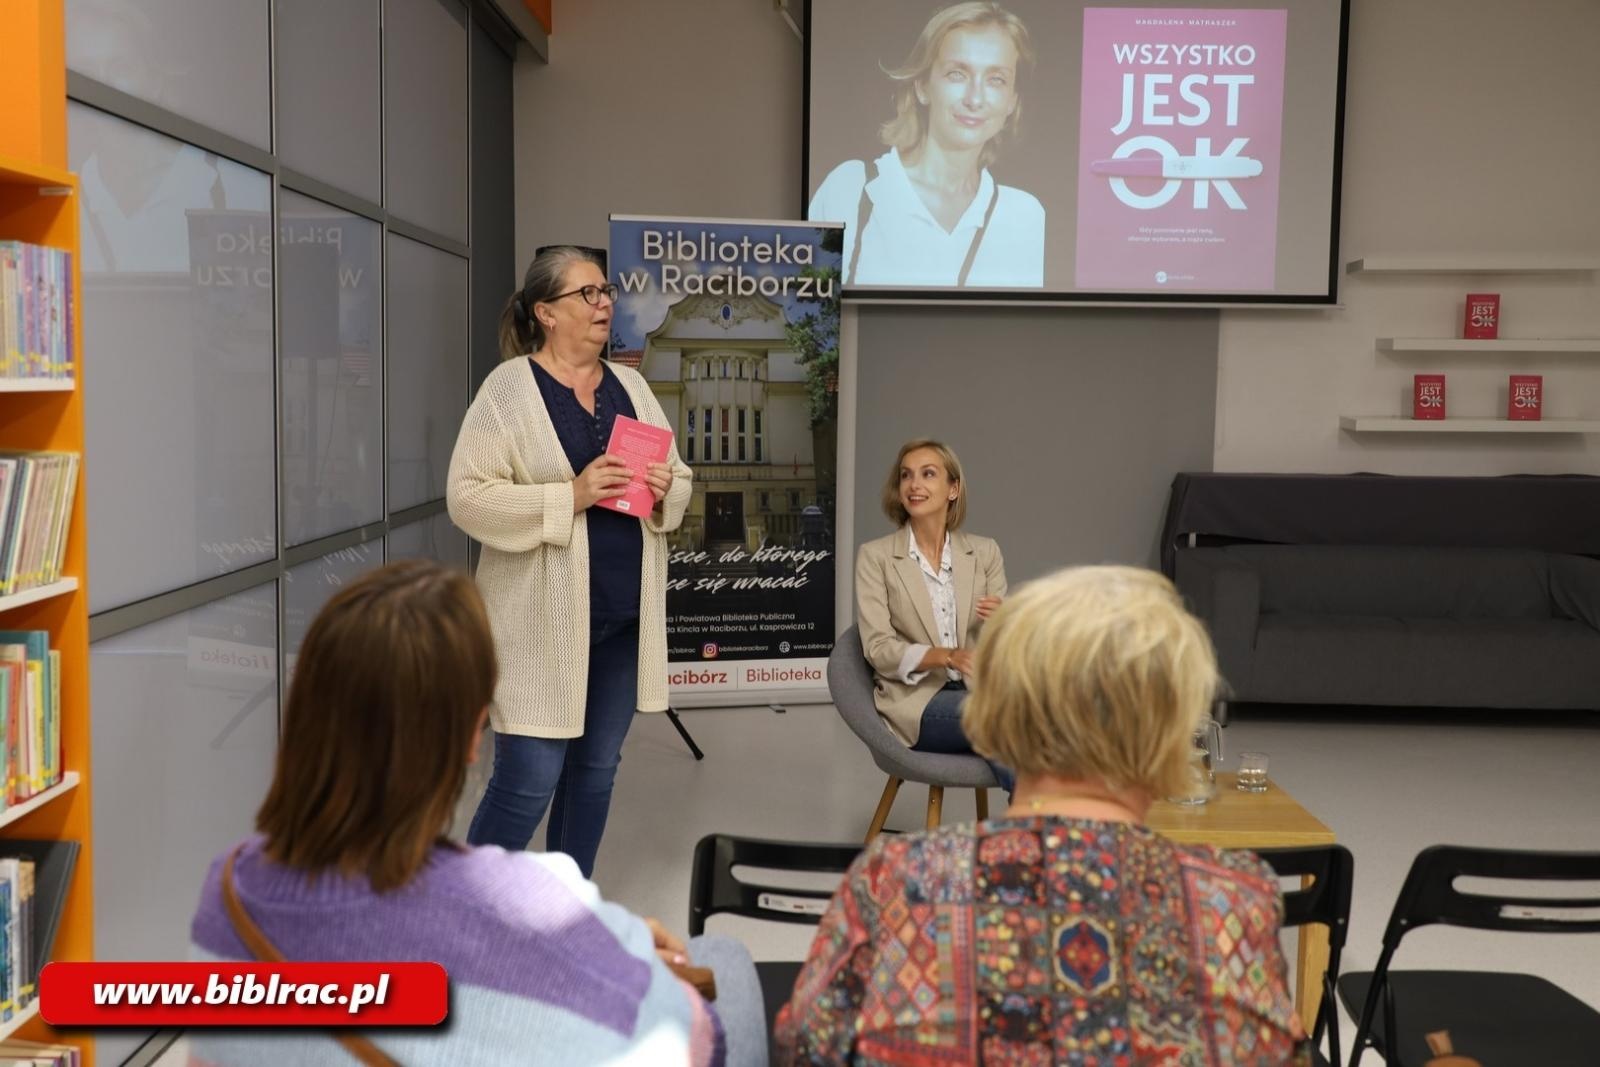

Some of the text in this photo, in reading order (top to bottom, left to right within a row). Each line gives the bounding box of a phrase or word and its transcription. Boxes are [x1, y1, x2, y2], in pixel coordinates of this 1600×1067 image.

[1113, 43, 1256, 66] WSZYSTKO
[1110, 73, 1255, 136] JEST
[1108, 135, 1251, 210] OK
[643, 230, 813, 265] Biblioteka
[618, 264, 833, 298] w Raciborzu
[1472, 306, 1494, 316] JEST
[1420, 387, 1441, 396] JEST
[1515, 387, 1537, 396] JEST
[719, 545, 751, 563] do
[749, 544, 832, 572] którego
[693, 572, 731, 594] się
[732, 572, 811, 590] wracać
[679, 614, 721, 623] Powiatowa
[722, 612, 759, 622] Biblioteka
[760, 611, 796, 621] Publiczna
[759, 622, 806, 633] Kasprowicza
[807, 621, 815, 630] 12
[668, 666, 822, 685] cibórz Biblioteka
